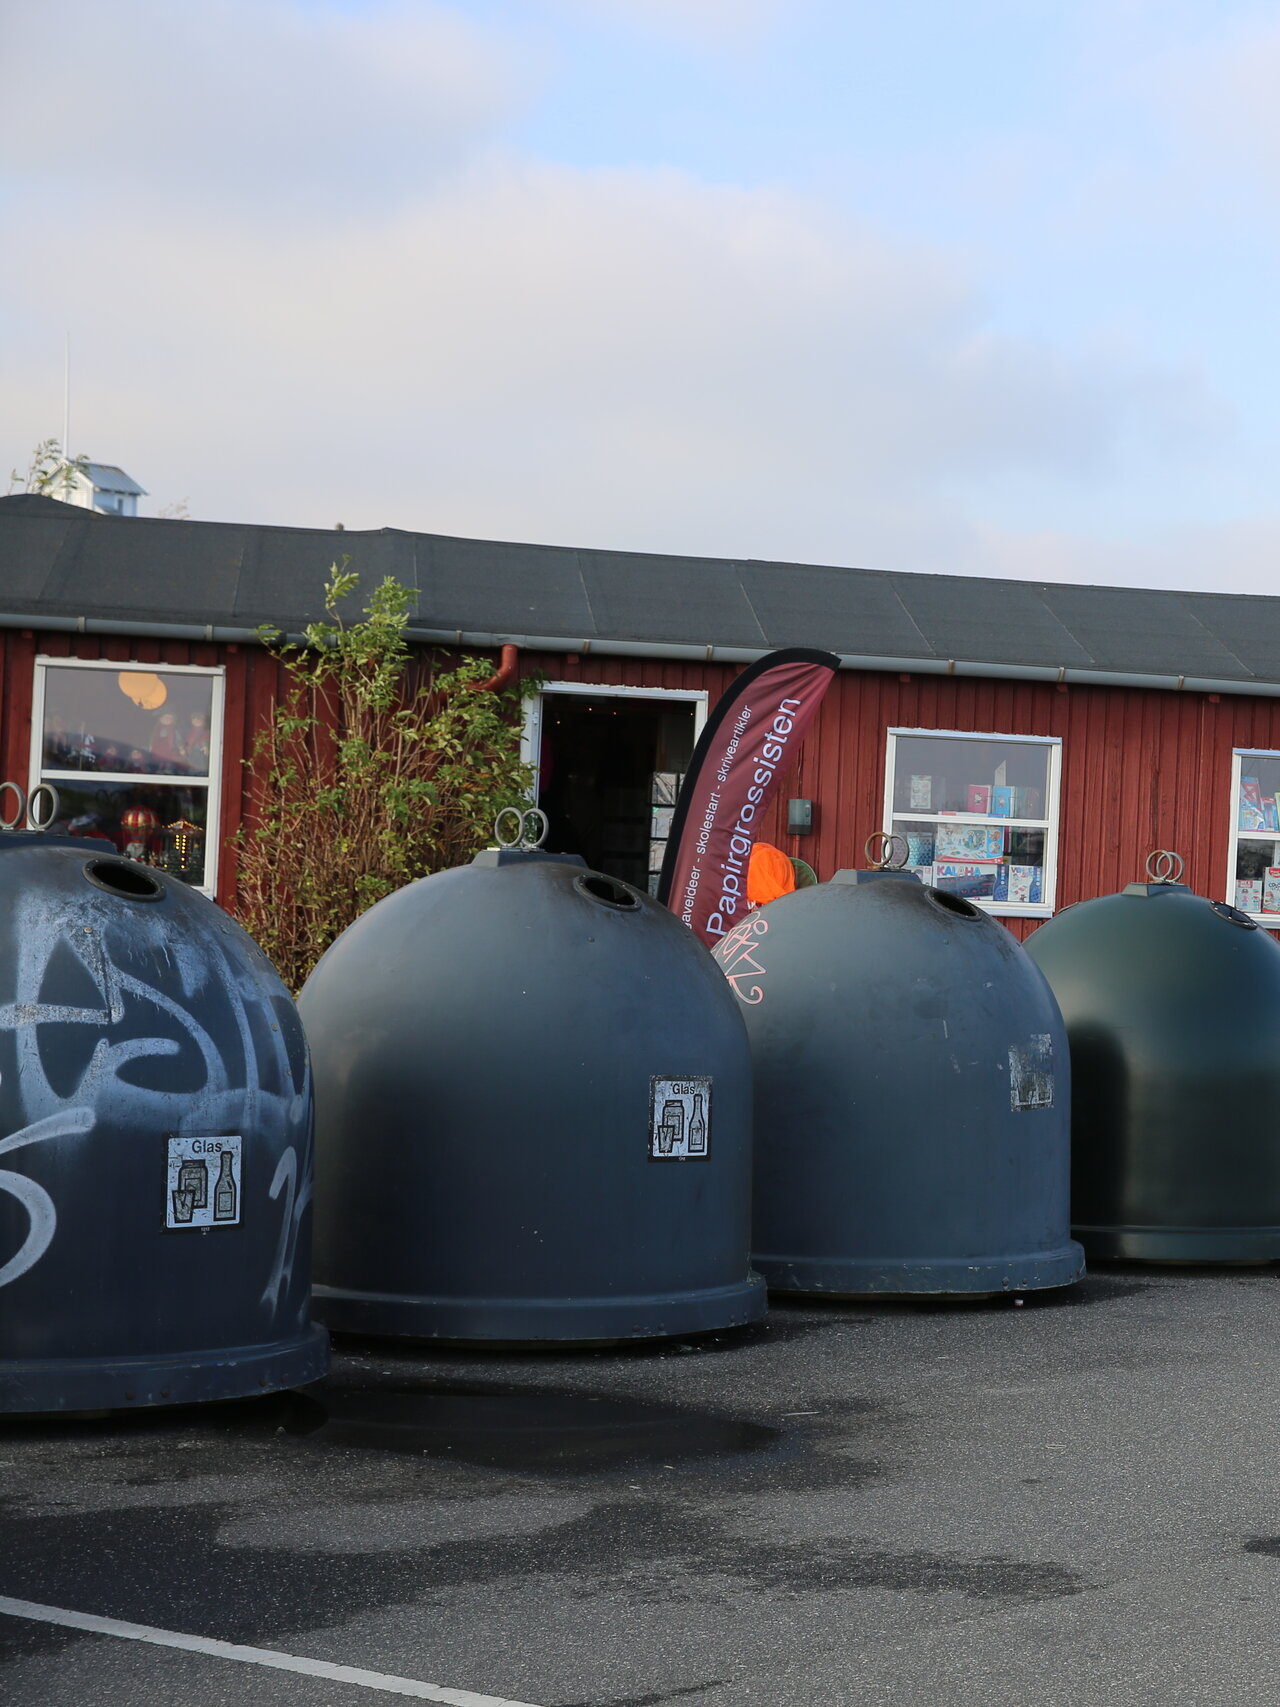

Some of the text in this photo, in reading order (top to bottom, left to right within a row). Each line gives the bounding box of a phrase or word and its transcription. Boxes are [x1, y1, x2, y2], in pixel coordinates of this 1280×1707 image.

[696, 792, 721, 855] skolestart
[717, 705, 752, 782] skriveartikler
[706, 698, 801, 937] Papirgrossisten
[672, 1083, 696, 1095] Glas
[191, 1140, 223, 1154] Glas
